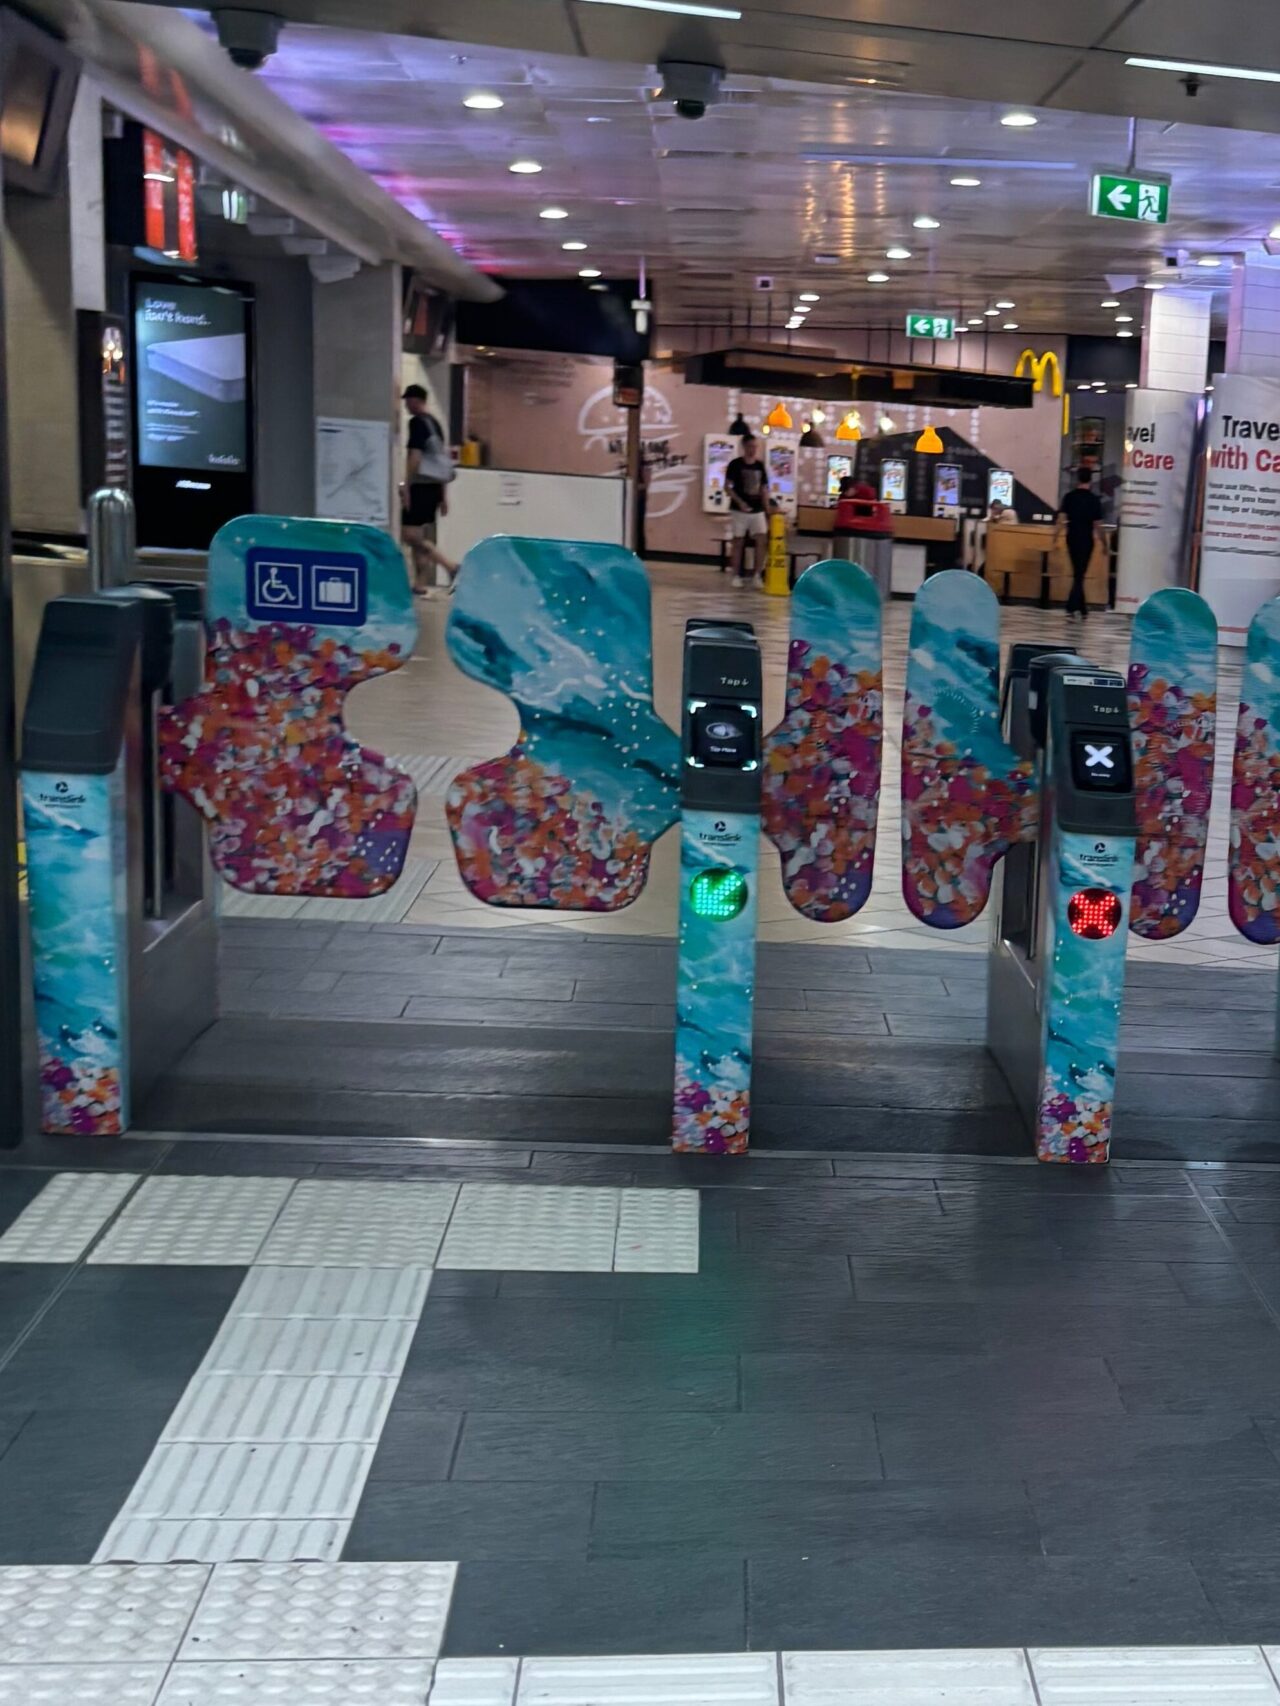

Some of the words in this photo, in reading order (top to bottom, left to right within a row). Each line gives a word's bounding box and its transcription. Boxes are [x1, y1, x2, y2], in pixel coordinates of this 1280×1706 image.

[1132, 449, 1174, 470] Care
[720, 677, 740, 686] Tap
[1093, 705, 1112, 714] Tap
